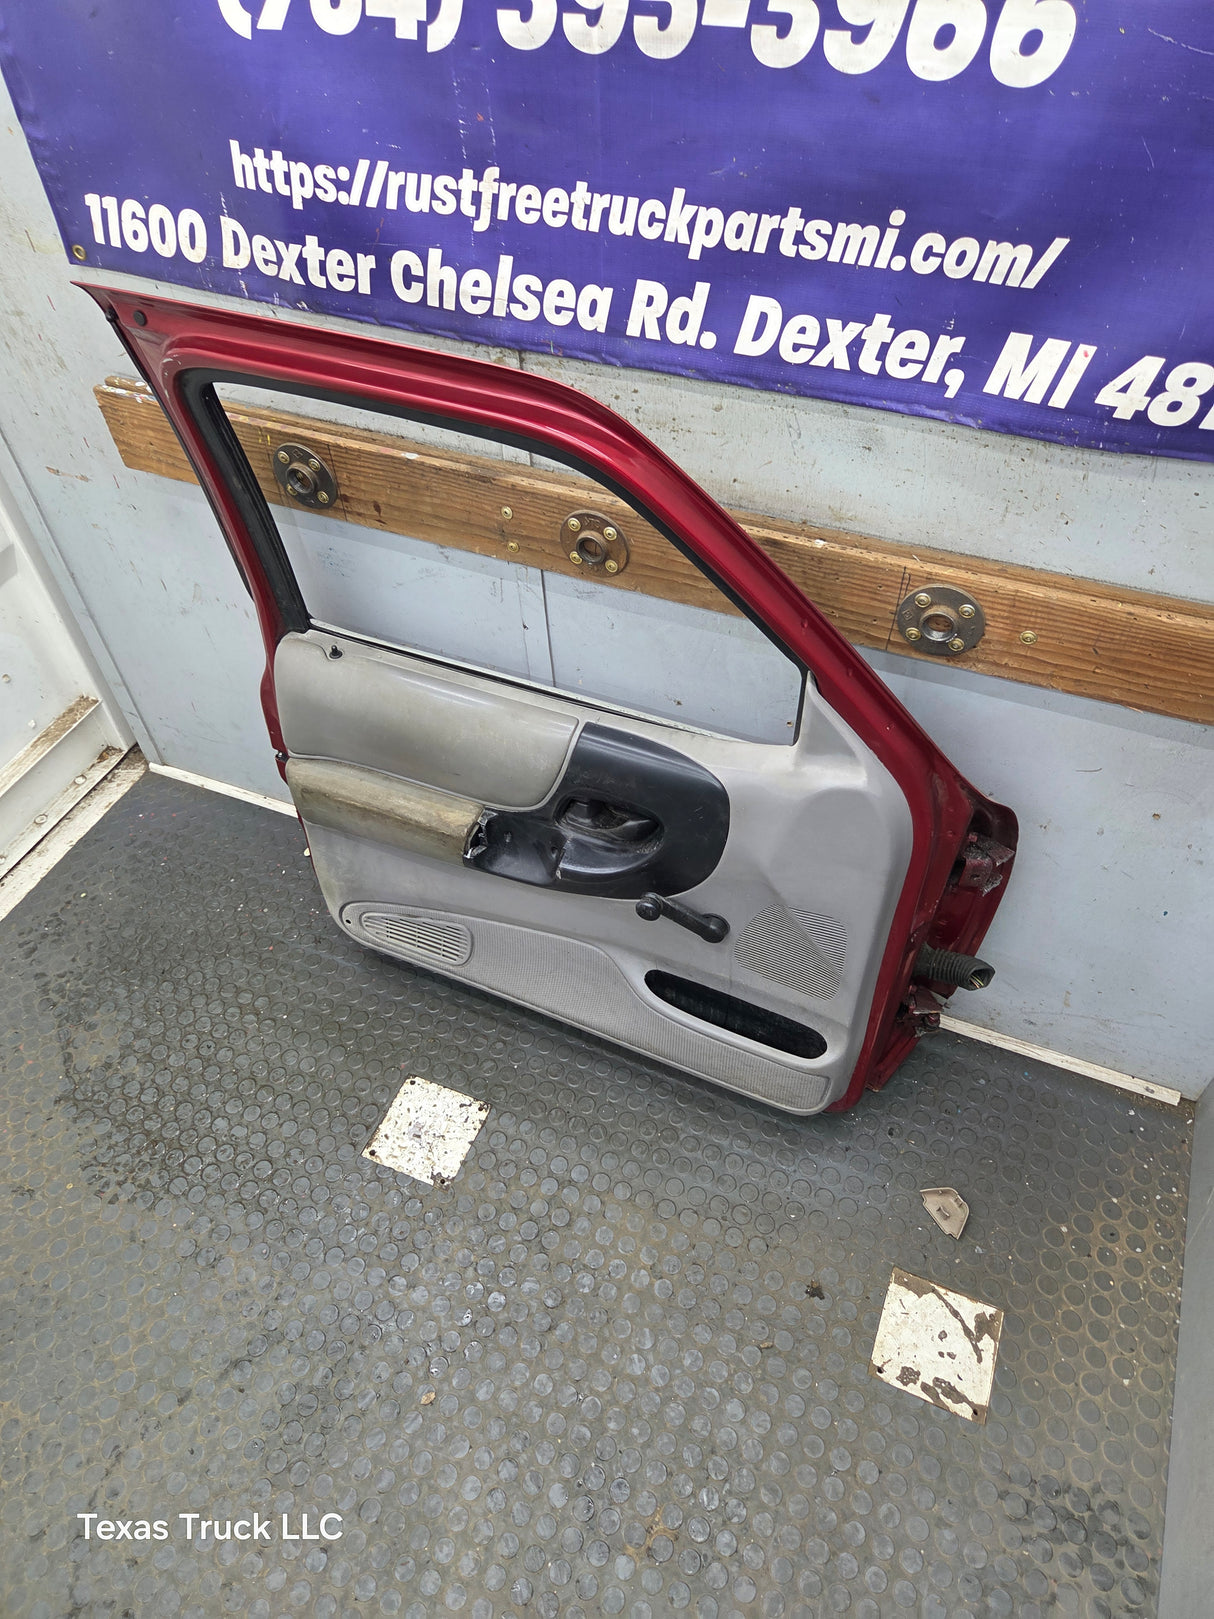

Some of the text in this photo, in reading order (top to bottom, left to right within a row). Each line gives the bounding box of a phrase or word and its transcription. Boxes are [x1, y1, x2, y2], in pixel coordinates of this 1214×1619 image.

[230, 140, 1070, 288] https://rustfreetruckpartsmi.com/
[85, 193, 1214, 431] 11600 Dexter Chelsea Rd. Dexter, MI 48
